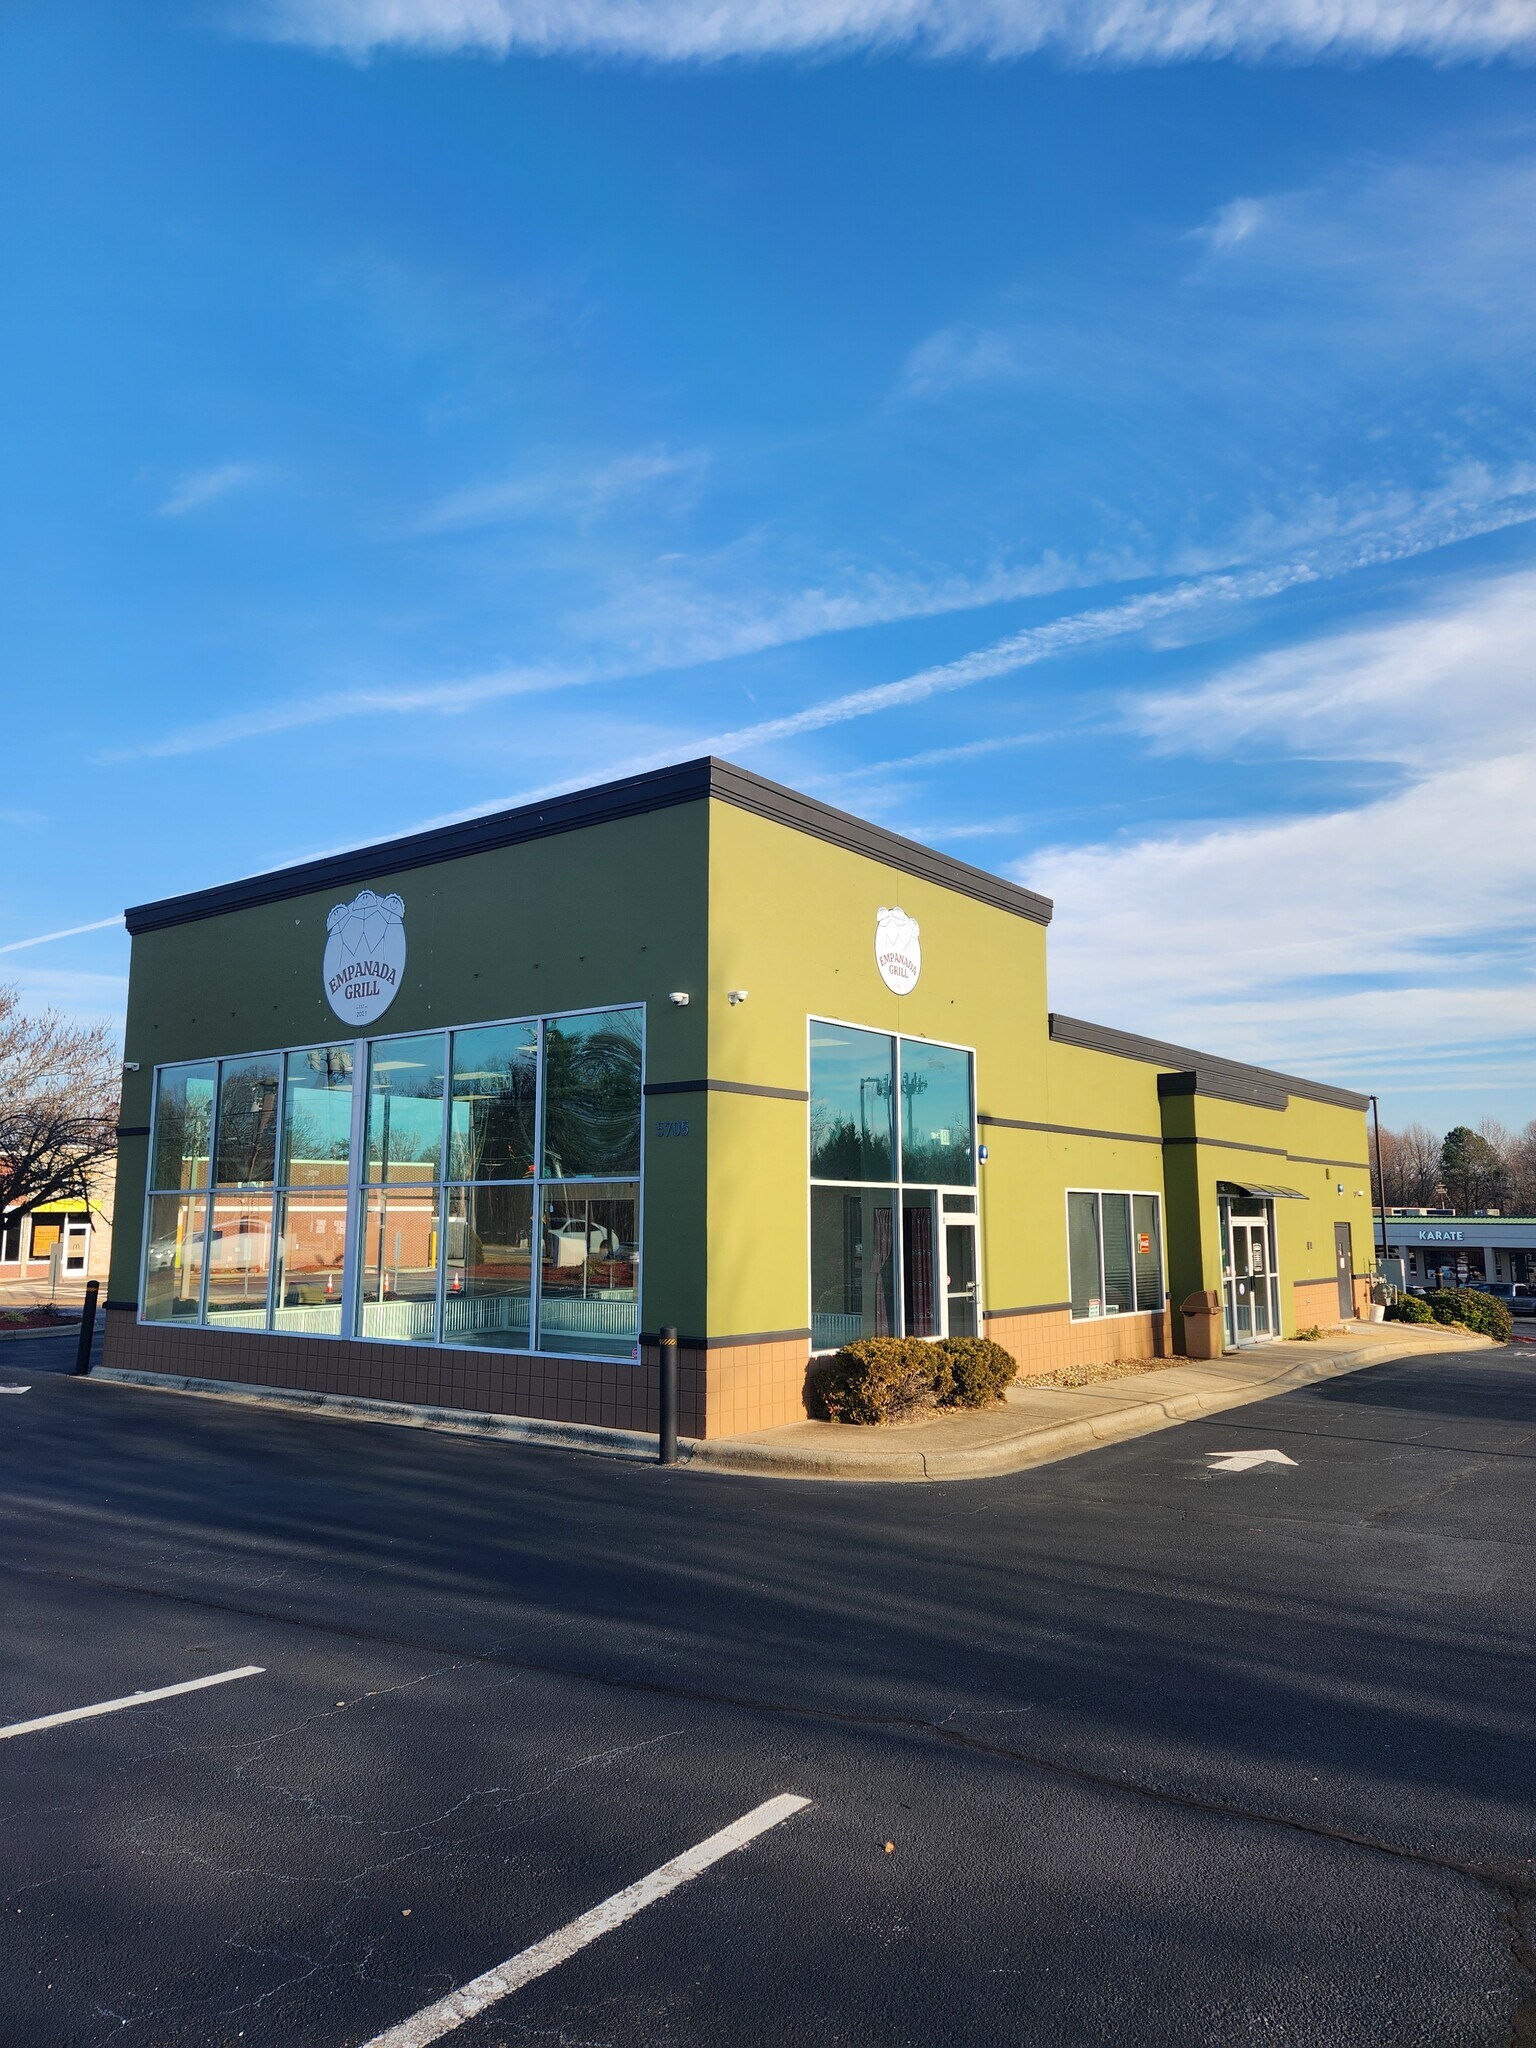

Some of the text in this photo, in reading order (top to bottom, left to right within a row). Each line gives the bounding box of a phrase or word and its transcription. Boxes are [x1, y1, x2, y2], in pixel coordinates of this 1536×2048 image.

[879, 952, 917, 976] EMPANADA
[889, 964, 909, 978] GRILL
[328, 960, 397, 995] EMPANADA
[344, 980, 380, 1000] GRILL
[656, 1120, 690, 1138] 5705
[1419, 1230, 1464, 1241] KARATE
